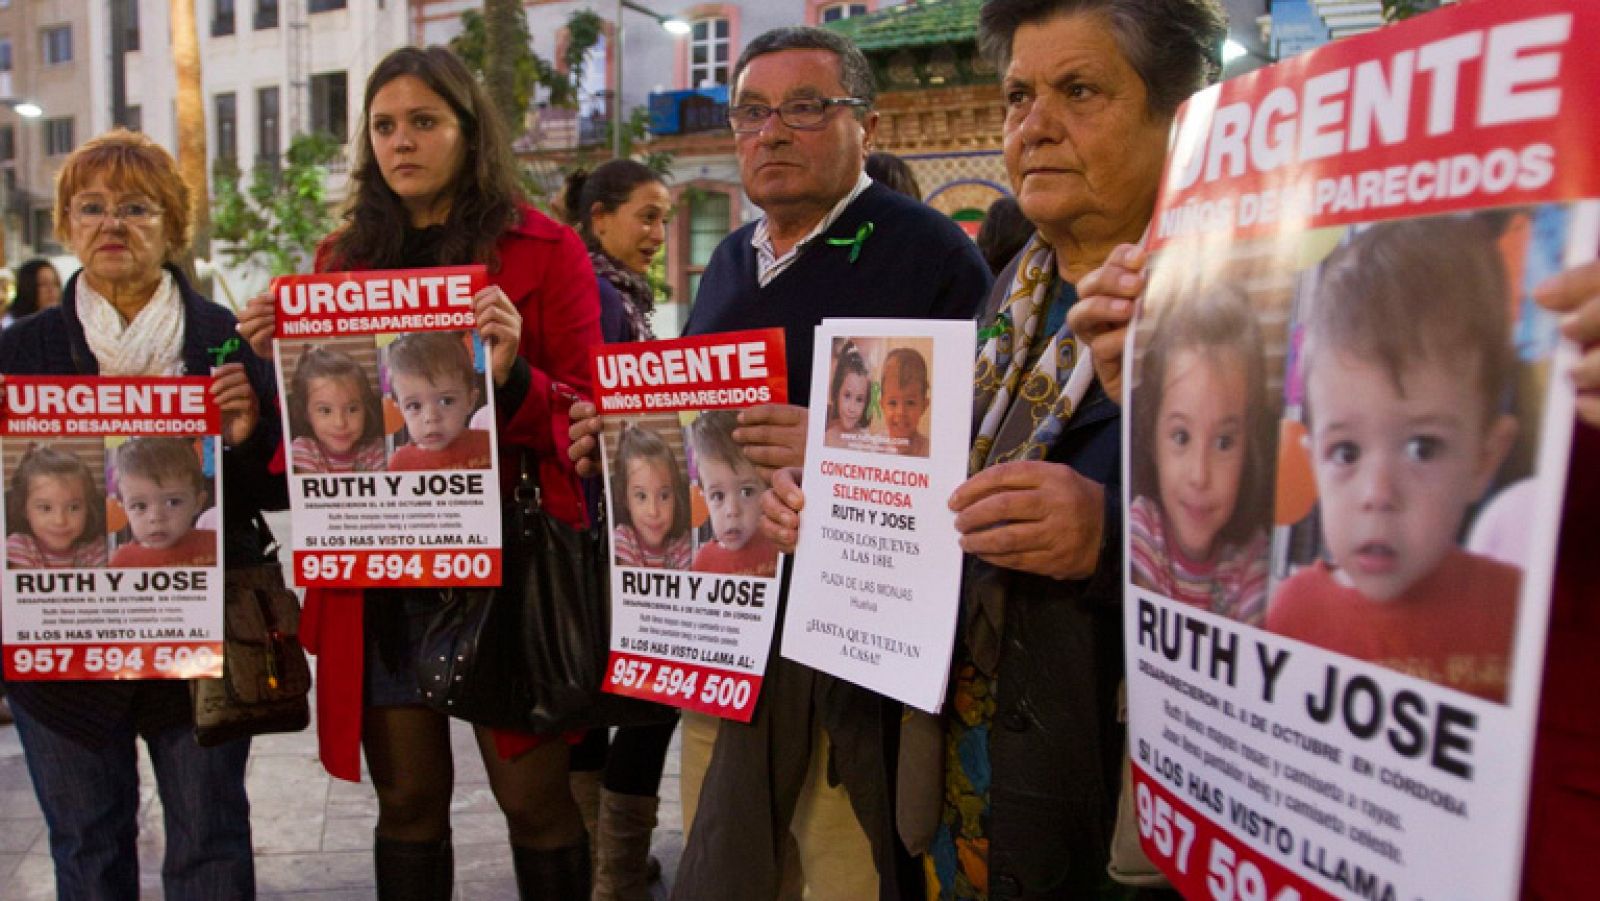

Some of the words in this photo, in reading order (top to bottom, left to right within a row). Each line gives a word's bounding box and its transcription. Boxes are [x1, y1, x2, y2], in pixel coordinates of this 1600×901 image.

[1170, 14, 1573, 191] URGENTE
[1238, 144, 1556, 227] DEAPARECIDOS
[280, 275, 472, 315] URGENTE
[283, 317, 333, 334] NIÑOS
[337, 312, 475, 331] DESAPARECIDOS
[597, 341, 768, 388] URGENTE
[6, 385, 206, 414] URGENTE
[602, 392, 642, 409] NIÑOS
[644, 386, 772, 407] DESAPARECIDOS
[8, 417, 61, 432] NIÑOS
[66, 418, 206, 432] DESAPARECIDOS
[302, 477, 376, 497] RUTH
[384, 475, 402, 496] Y
[412, 473, 484, 495] JOSE
[821, 461, 929, 488] CONCENTRACION
[833, 484, 912, 508] SILENCIOSA
[832, 505, 865, 522] RUTH
[869, 510, 877, 524] Y
[881, 513, 916, 531] JOSE
[305, 536, 318, 547] SI
[321, 536, 346, 546] LOS
[350, 536, 375, 545] HAS
[378, 535, 415, 545] VISTO
[419, 535, 463, 545] LLAMA
[467, 534, 488, 545] AL:
[822, 528, 854, 544] TODOS
[856, 534, 877, 548] LOS
[877, 538, 920, 555] JUEVES
[302, 555, 357, 581] 957
[367, 554, 423, 579] 594
[432, 553, 491, 578] 500
[842, 549, 848, 559] A
[850, 549, 869, 563] LAS
[16, 573, 96, 593] RUTH
[105, 572, 124, 592] Y
[134, 571, 208, 591] JOSE
[623, 571, 680, 599] RUTH
[688, 576, 702, 601] Y
[707, 578, 767, 608] JOSE
[821, 571, 844, 586] PLAZA
[846, 577, 856, 590] DE
[860, 581, 875, 593] LAS
[877, 583, 913, 600] MONJAS
[17, 630, 30, 640] SI
[34, 630, 61, 640] LOS
[65, 629, 92, 639] HAS
[97, 628, 136, 639] VISTO
[140, 627, 184, 639] LLAMA
[846, 628, 868, 645] QUE
[871, 634, 920, 658] VUELVAN
[14, 648, 74, 673] 957
[85, 647, 144, 672] 594
[154, 646, 214, 671] 500
[621, 636, 629, 649] SI
[631, 639, 649, 651] LOS
[650, 642, 669, 655] HAS
[671, 645, 698, 660] VISTO
[700, 650, 734, 666] LLAMA
[737, 655, 755, 669] AL:
[841, 645, 848, 655] A
[611, 658, 652, 688] 957
[653, 665, 698, 699] 594
[702, 674, 750, 710] 500
[1138, 598, 1239, 688] RUTH
[1256, 641, 1291, 704] Y
[1306, 664, 1479, 781] JOSE
[1251, 712, 1267, 733] DE
[1272, 723, 1342, 765] OCTUBRE
[1139, 738, 1151, 765] SI
[1154, 748, 1184, 788] LOS
[1188, 771, 1224, 815] HAS
[1228, 796, 1293, 856] VISTO
[1302, 838, 1399, 901] LLAMA
[1137, 780, 1196, 875] 957
[1206, 838, 1302, 901] 59
